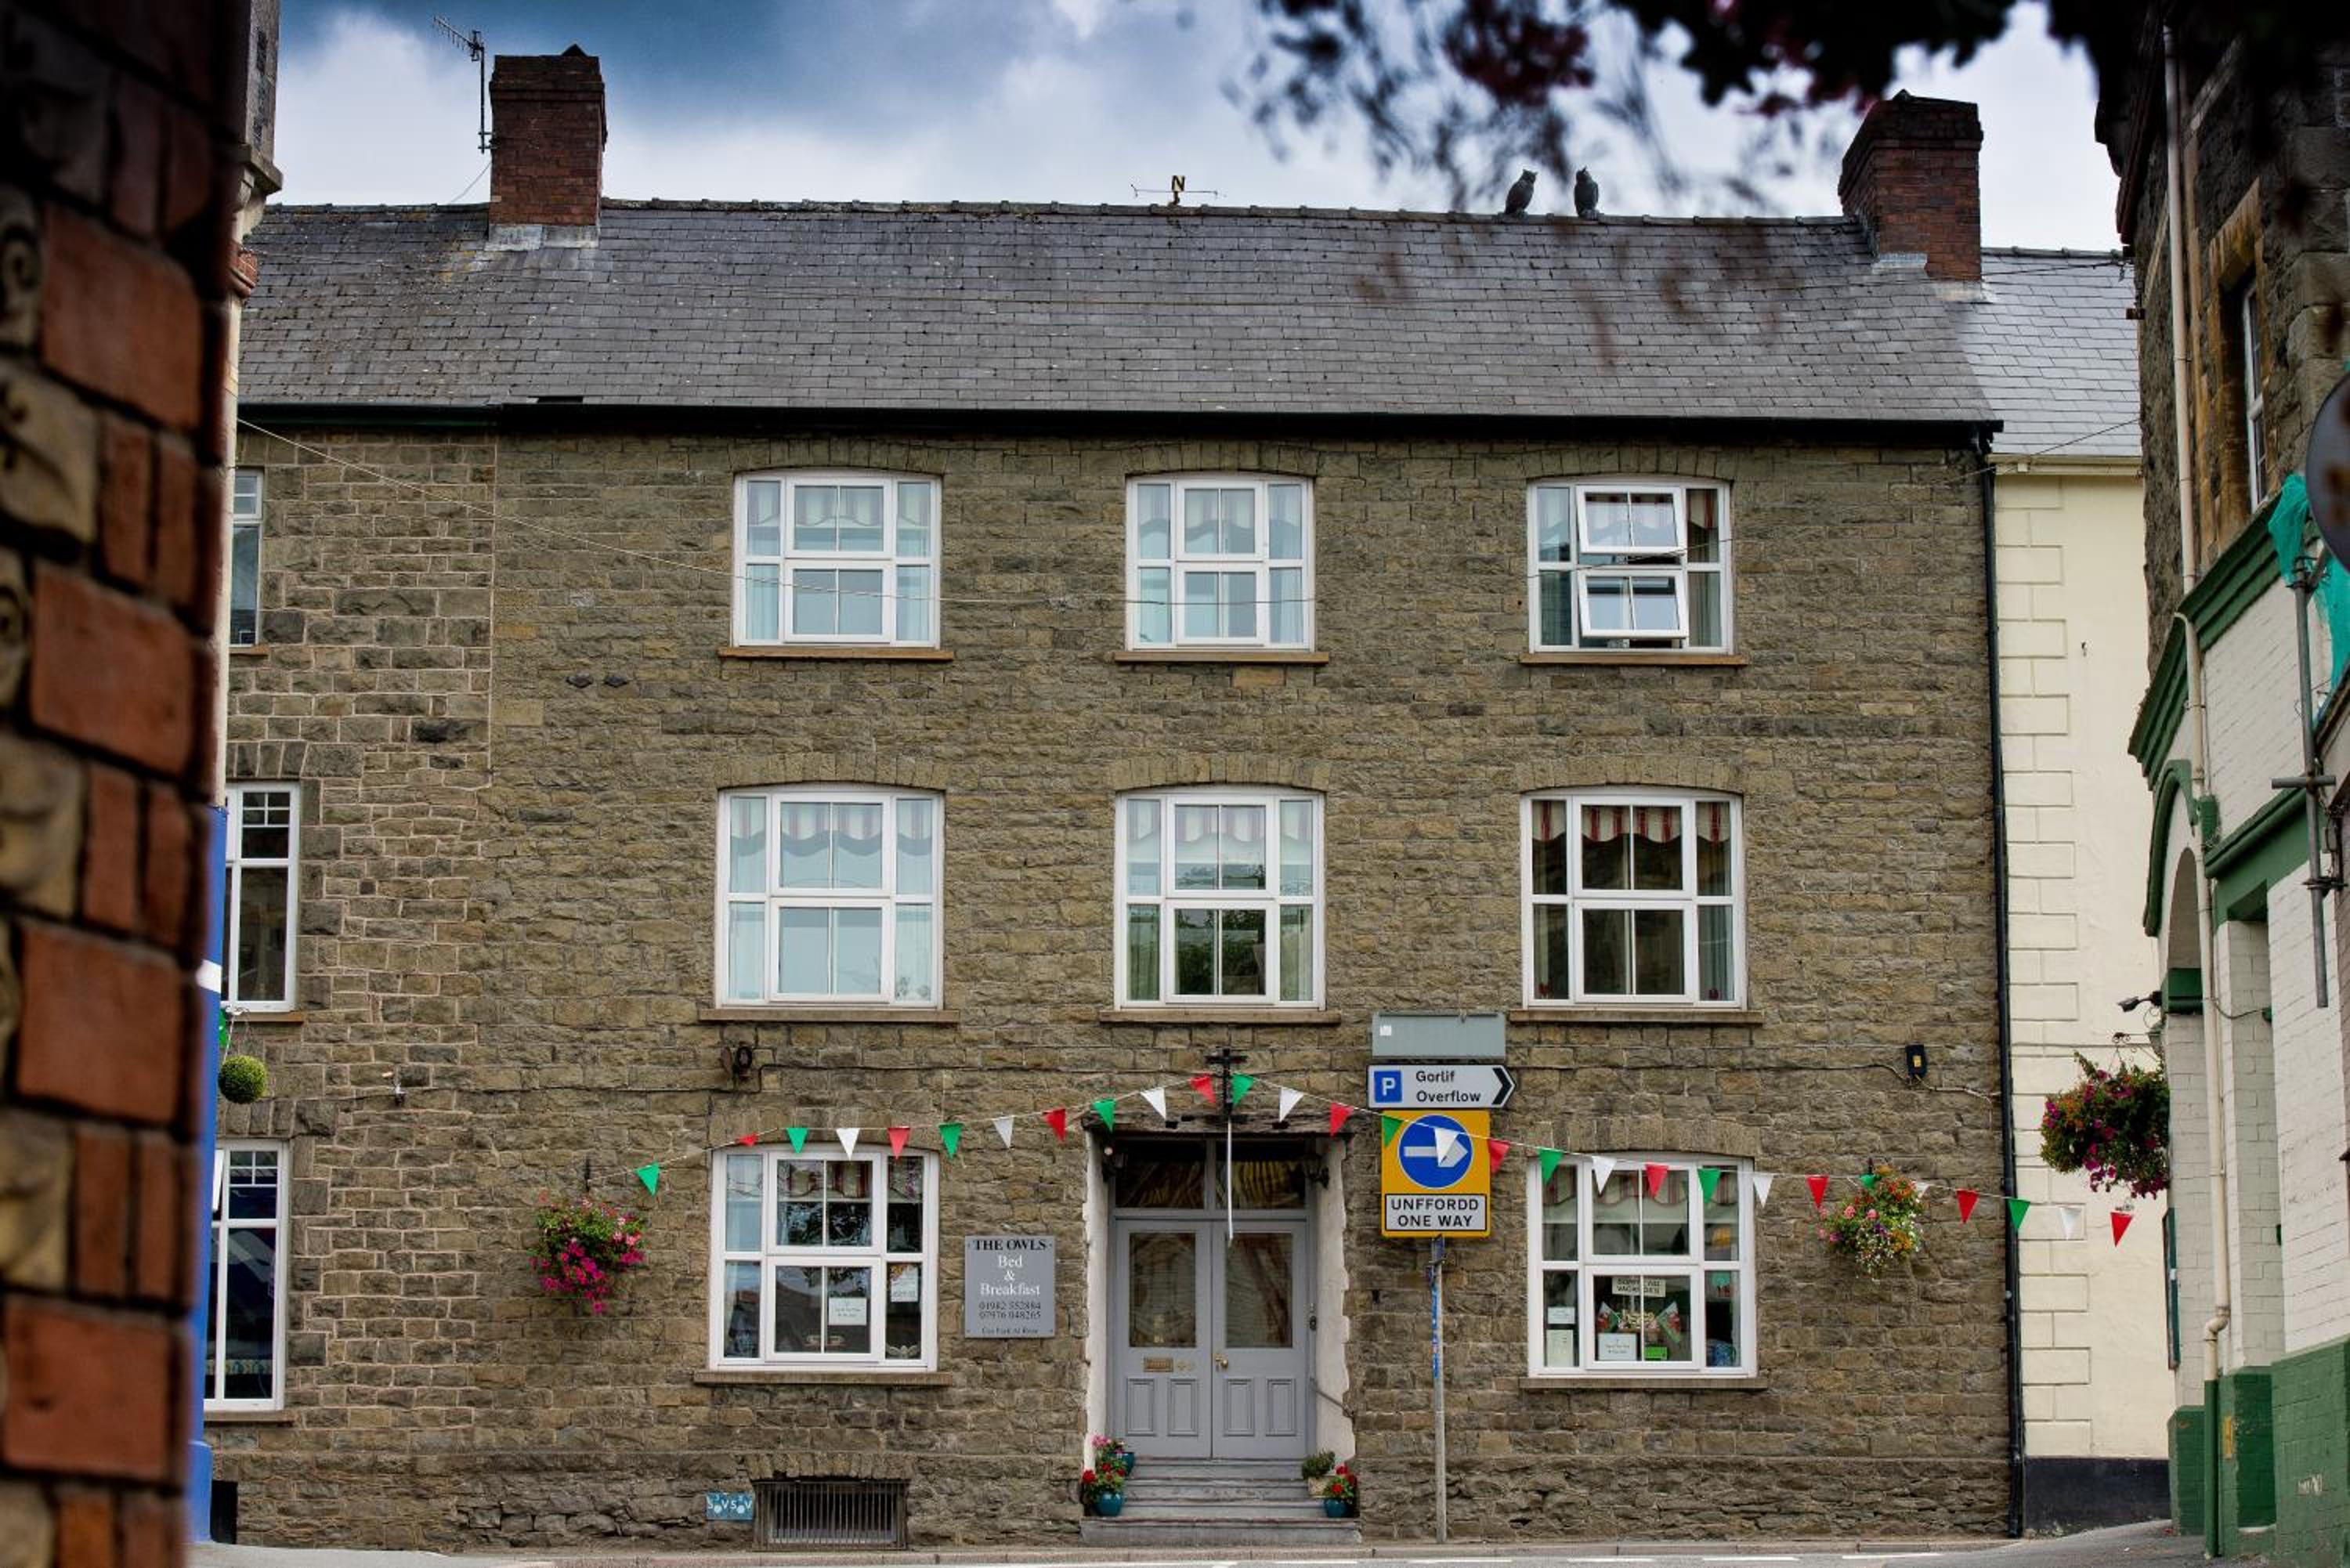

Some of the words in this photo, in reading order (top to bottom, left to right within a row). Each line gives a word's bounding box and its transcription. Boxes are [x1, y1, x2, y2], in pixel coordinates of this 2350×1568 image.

[1172, 175, 1185, 192] N
[1415, 1071, 1455, 1082] Gorlif
[1383, 1078, 1396, 1096] P
[1416, 1090, 1481, 1103] Overflow
[1391, 1198, 1479, 1210] UNFFORDD
[1397, 1215, 1431, 1227] ONE
[1438, 1215, 1473, 1227] WAY
[974, 1240, 1003, 1251] THE
[1007, 1239, 1047, 1251] OWLS
[998, 1255, 1023, 1268] Bed
[1004, 1270, 1015, 1281] &
[980, 1282, 1041, 1296] Breakfast
